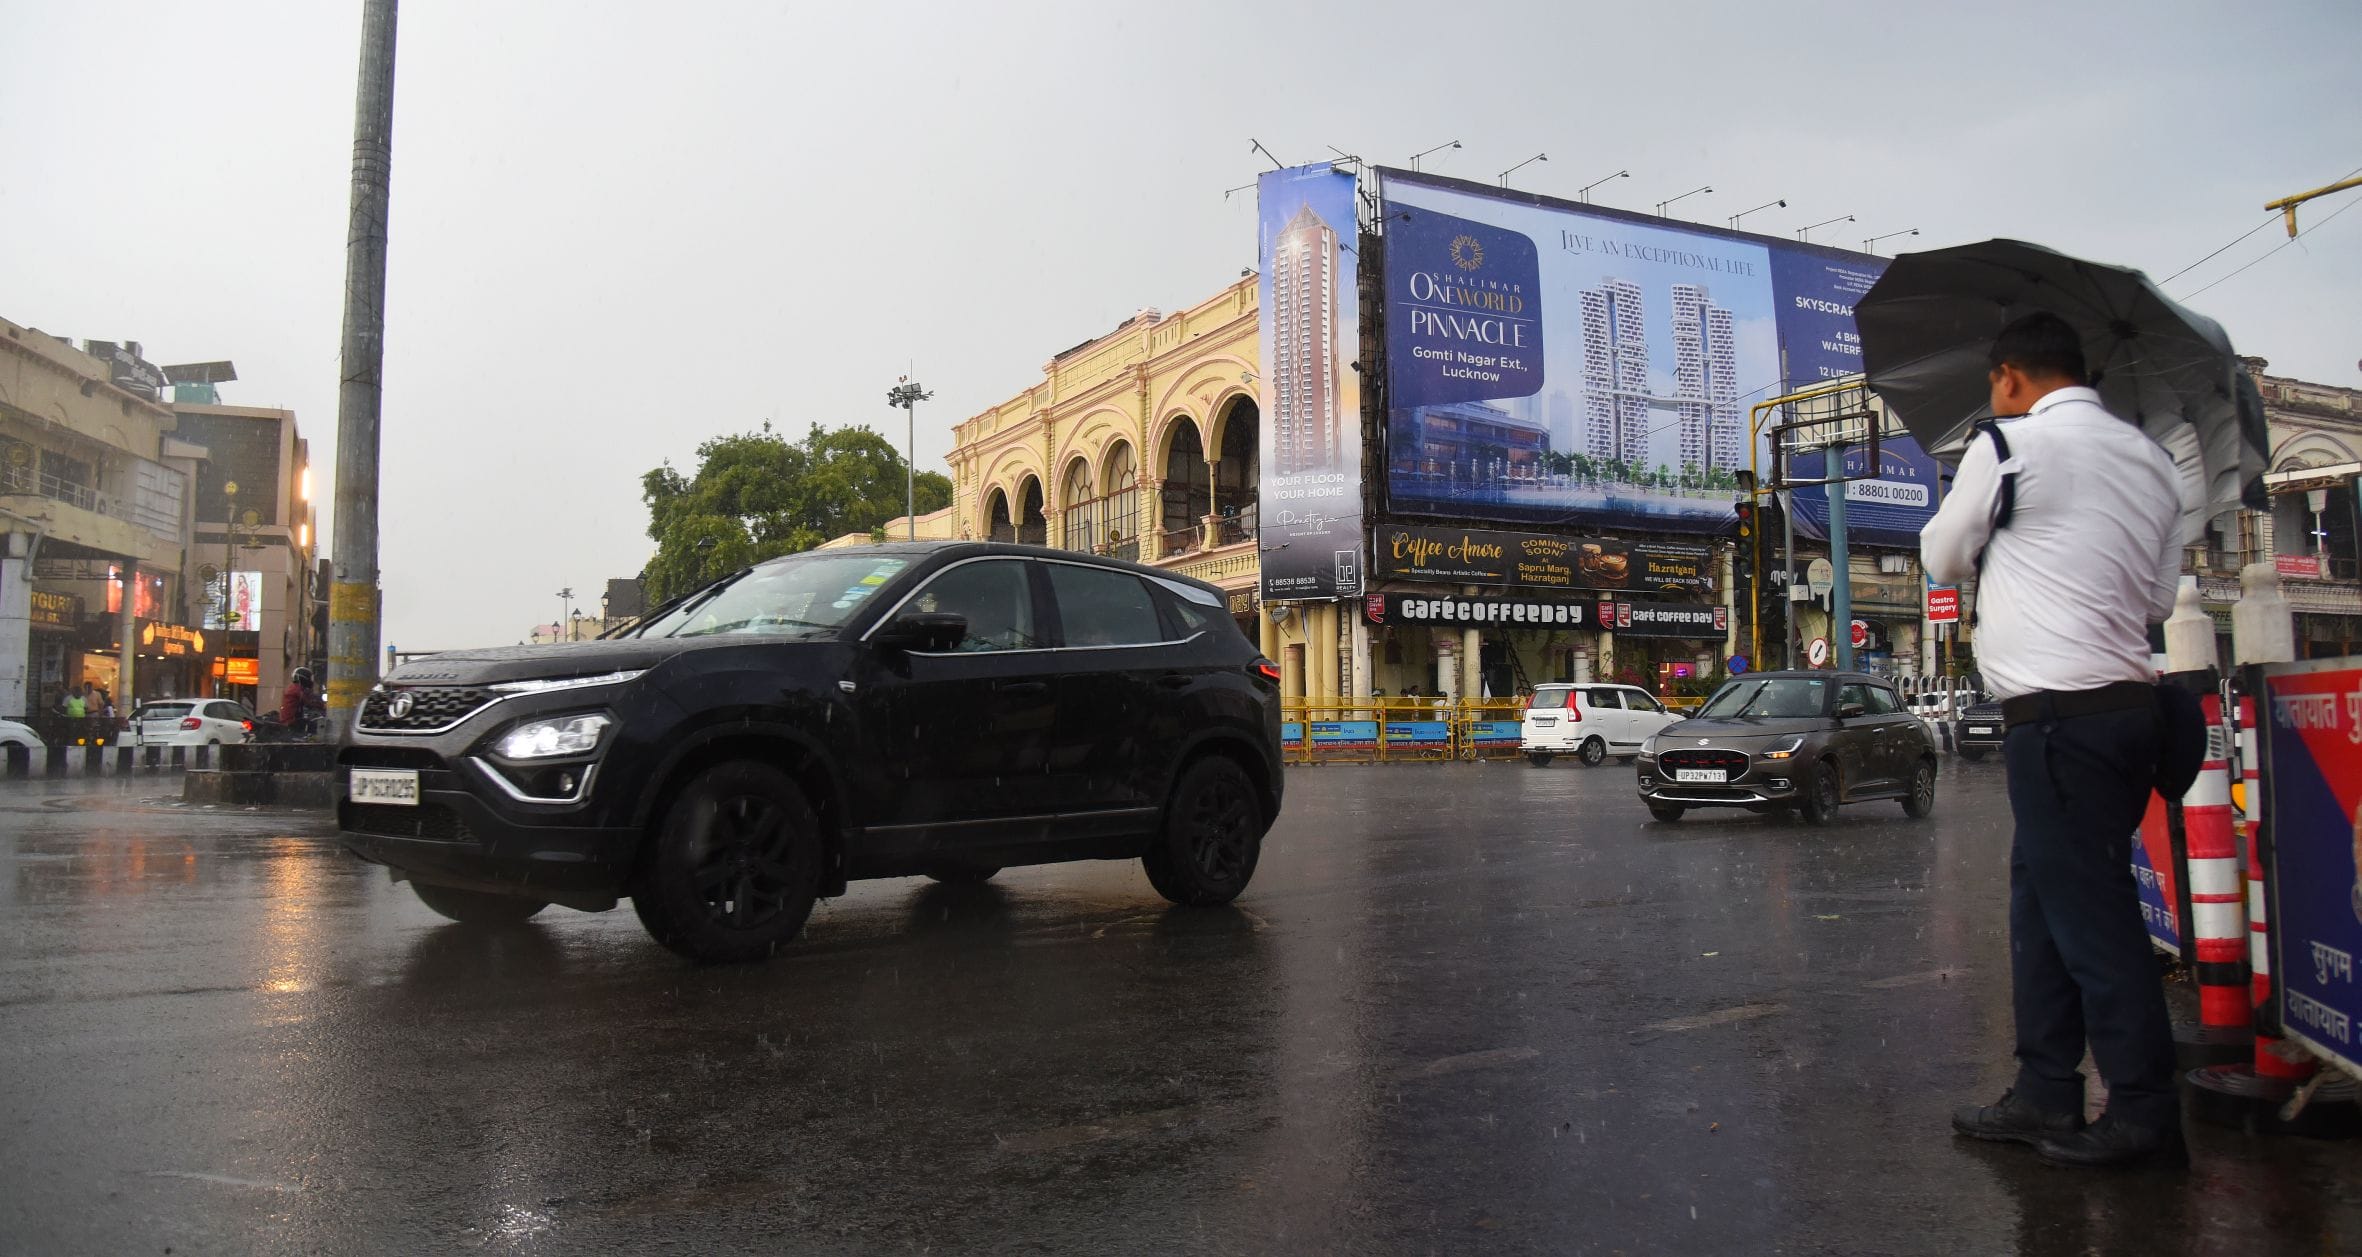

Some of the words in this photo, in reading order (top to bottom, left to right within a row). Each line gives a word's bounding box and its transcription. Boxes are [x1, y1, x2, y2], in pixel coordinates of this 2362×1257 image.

[1562, 230, 1594, 255] LIVE
[1600, 240, 1618, 256] AN
[1624, 244, 1722, 272] EXCEPTIONAL
[1726, 260, 1755, 277] LIFE
[1433, 272, 1520, 293] SHALIMAR
[1412, 310, 1528, 348] PINNACLE
[1836, 332, 1842, 340] 4
[1412, 346, 1452, 361] Gomti
[1458, 352, 1496, 366] Nagar
[1500, 357, 1528, 372] Ext.,
[1442, 365, 1500, 382] Lucknow
[1819, 366, 1828, 376] 12
[1271, 476, 1302, 487] YOUR
[1304, 474, 1344, 484] FLOOR
[1274, 490, 1305, 500] YOUR
[1308, 487, 1344, 498] HOME
[1858, 484, 1890, 498] 88801
[1892, 488, 1922, 501] 00200
[1392, 532, 1444, 566] Coffee
[1448, 536, 1503, 564] Amore
[1521, 540, 1568, 550] COMING
[1526, 548, 1564, 558] SOON!
[1518, 562, 1544, 573] Sapru
[1648, 562, 1696, 576] Hazratganj
[1522, 573, 1569, 584] Hazratganj
[1930, 605, 1956, 613] Surgery
[2274, 693, 2336, 728] यातायात
[2309, 940, 2352, 985] सुगम
[2286, 988, 2350, 1044] यातायात
